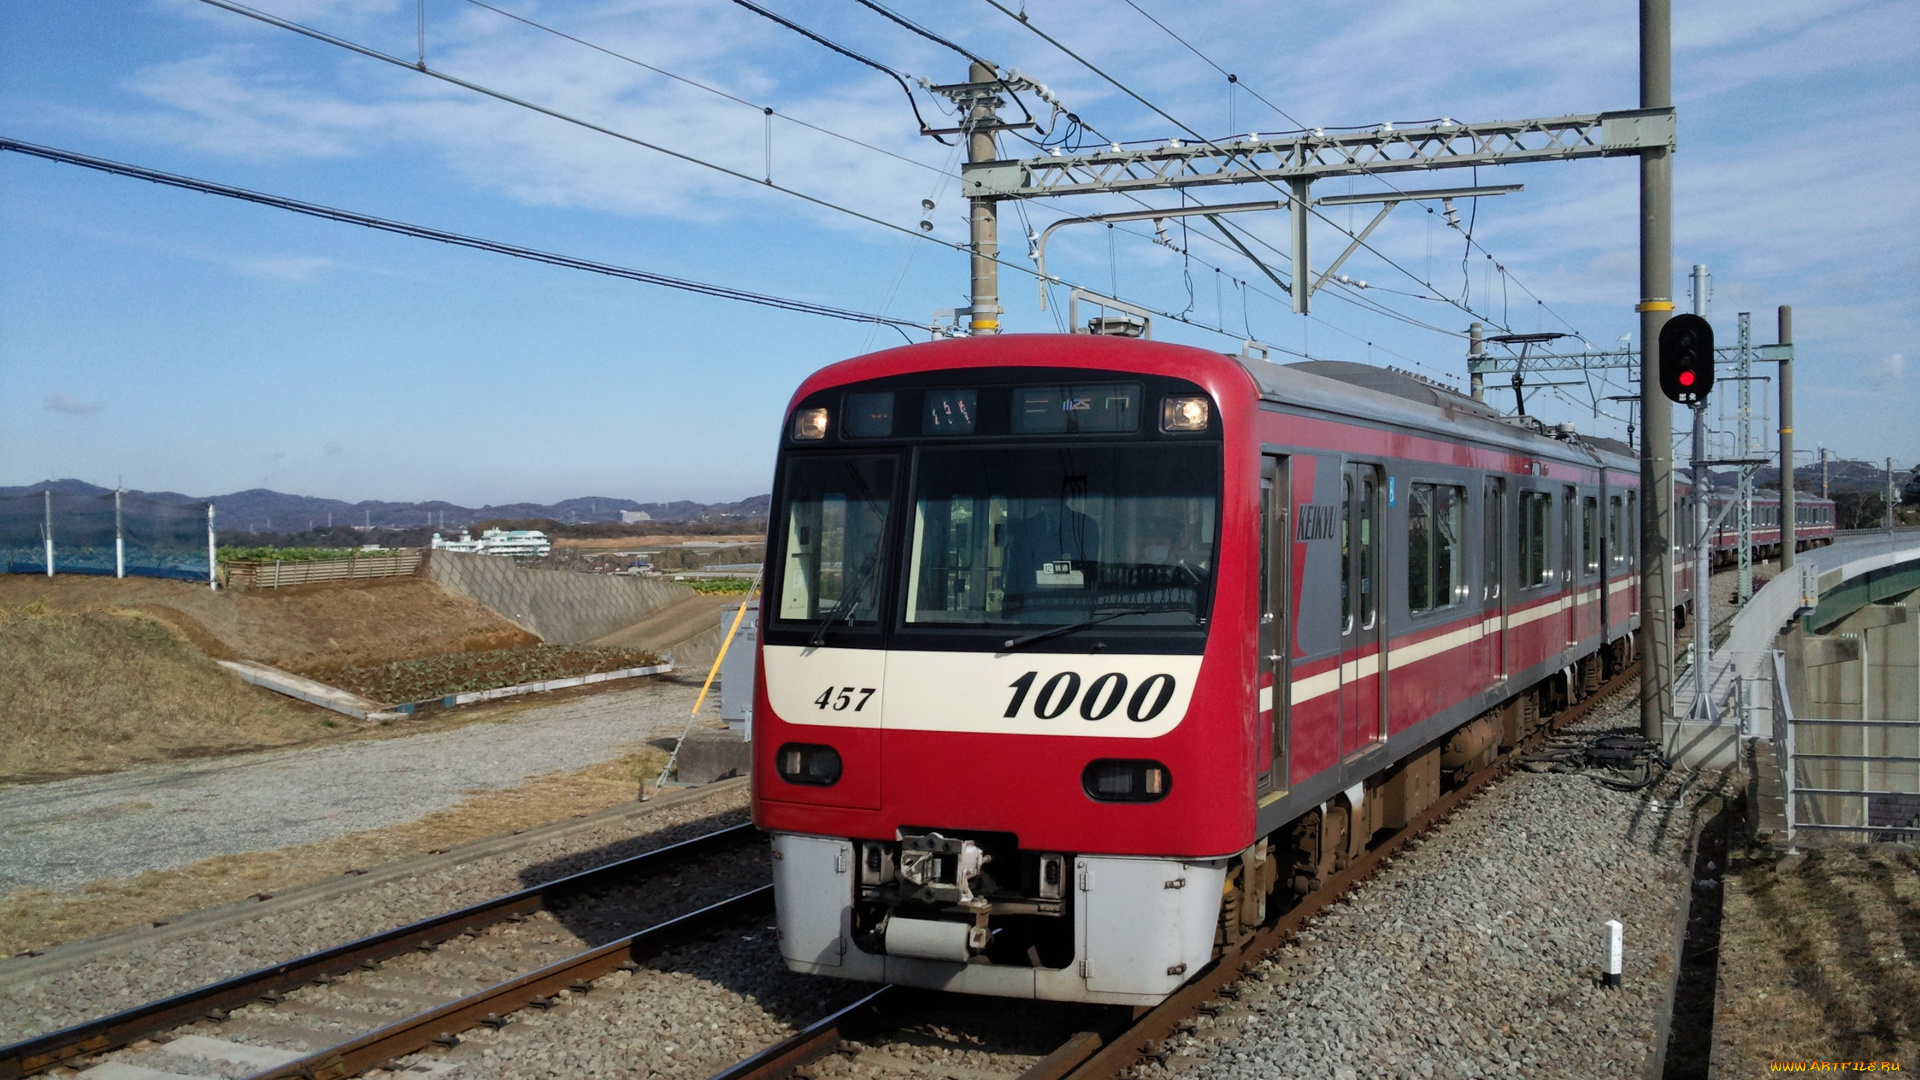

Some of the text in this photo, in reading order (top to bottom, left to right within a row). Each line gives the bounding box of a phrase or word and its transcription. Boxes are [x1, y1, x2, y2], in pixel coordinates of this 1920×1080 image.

[1296, 505, 1338, 540] KEIKYU
[814, 685, 877, 712] 457
[1003, 671, 1176, 723] 1000
